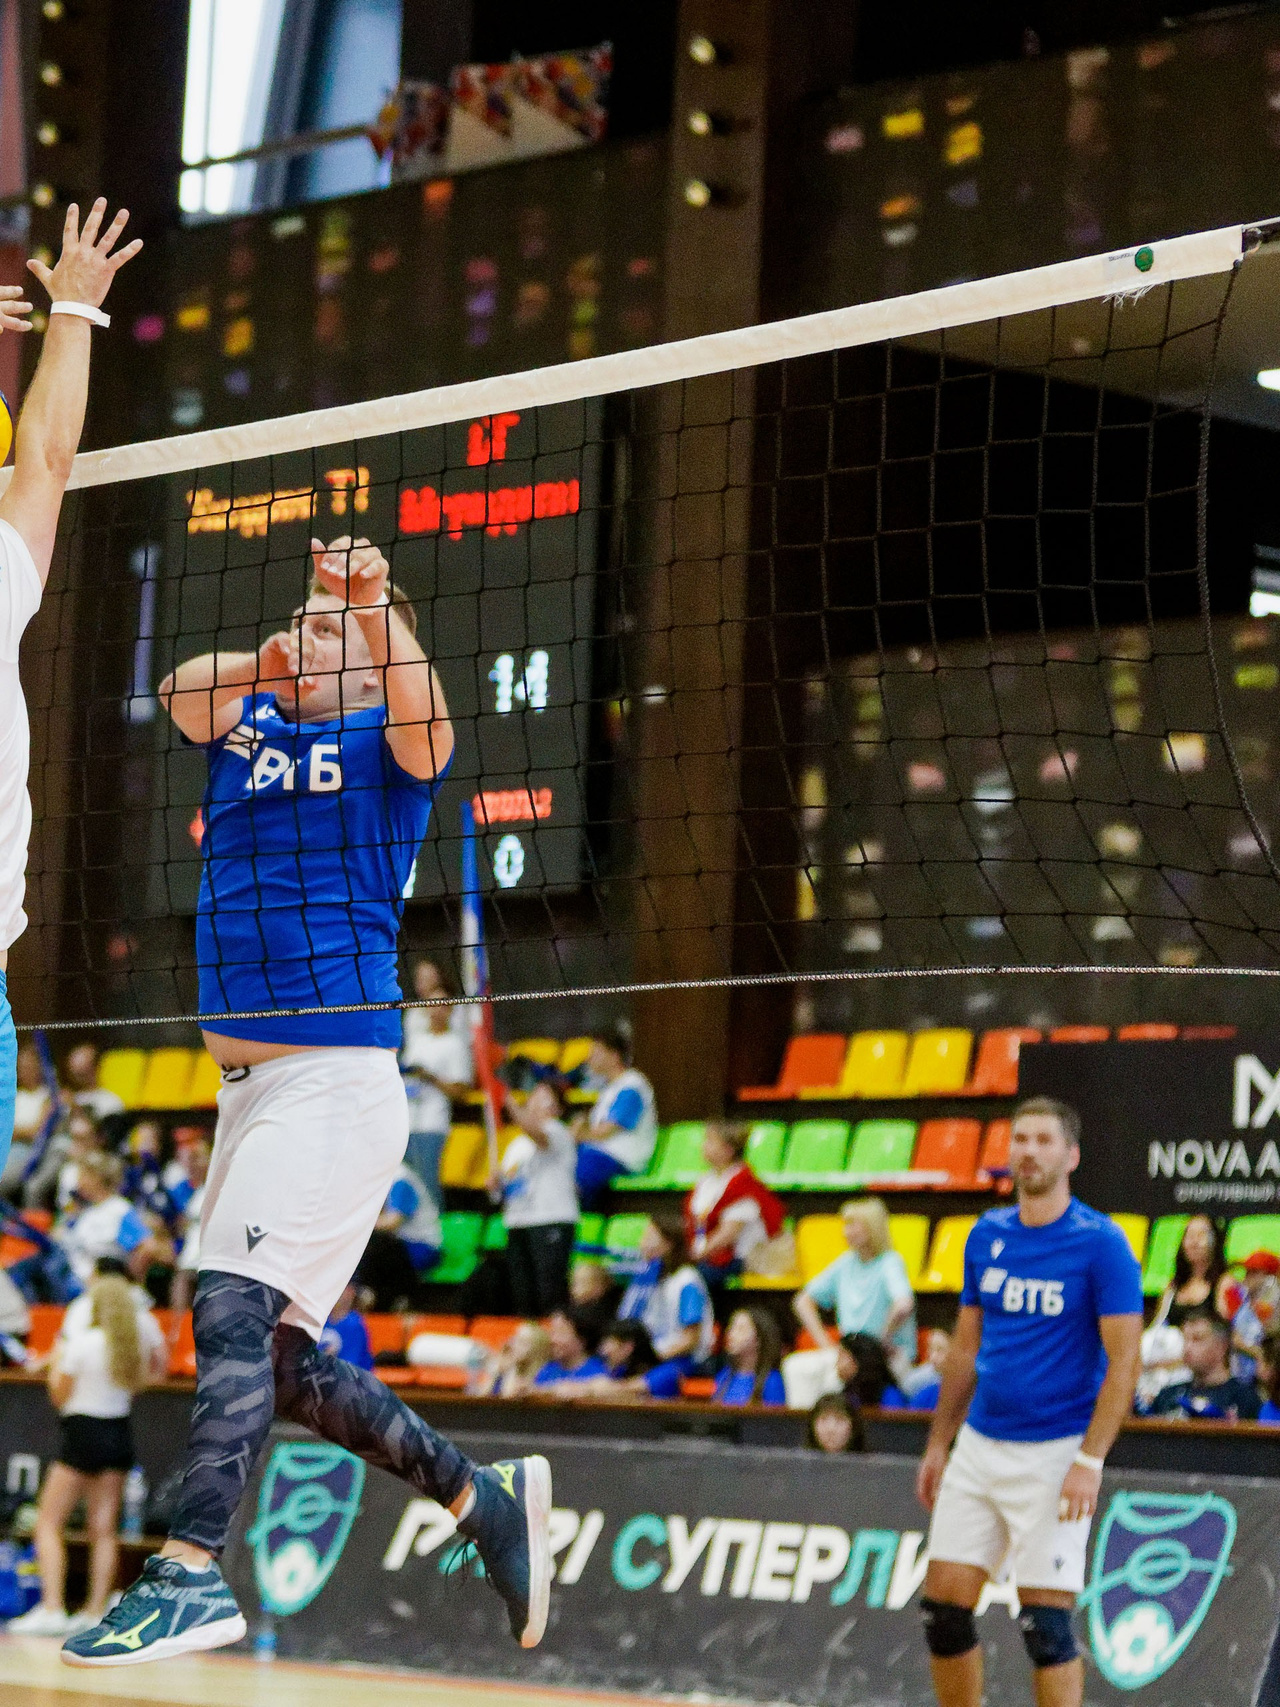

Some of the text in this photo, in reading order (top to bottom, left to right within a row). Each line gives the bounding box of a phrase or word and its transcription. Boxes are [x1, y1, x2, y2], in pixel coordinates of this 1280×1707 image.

[494, 834, 525, 888] 0
[1147, 1138, 1252, 1179] NOVA
[1002, 1275, 1065, 1317] ВТБ
[611, 1512, 1022, 1619] СУПЕРЛИА
